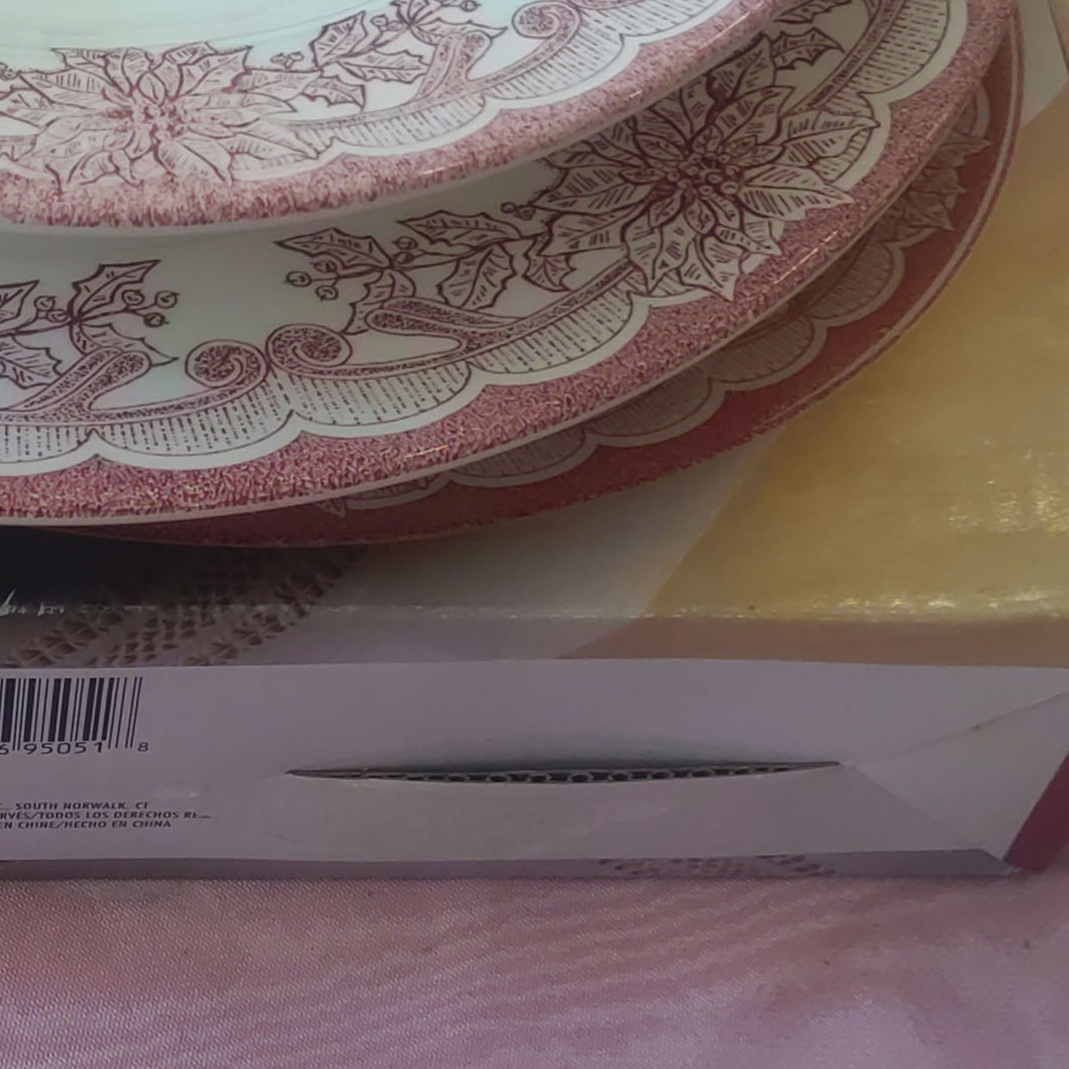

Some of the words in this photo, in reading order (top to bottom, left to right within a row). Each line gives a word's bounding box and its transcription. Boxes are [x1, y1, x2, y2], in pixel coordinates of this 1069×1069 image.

[22, 741, 103, 755] 95051
[137, 742, 149, 753] 8
[15, 802, 57, 811] SOUTH
[85, 811, 109, 819] LOS
[113, 810, 179, 819] DERECHOS
[111, 820, 127, 828] EN
[132, 819, 171, 828] CHINA
